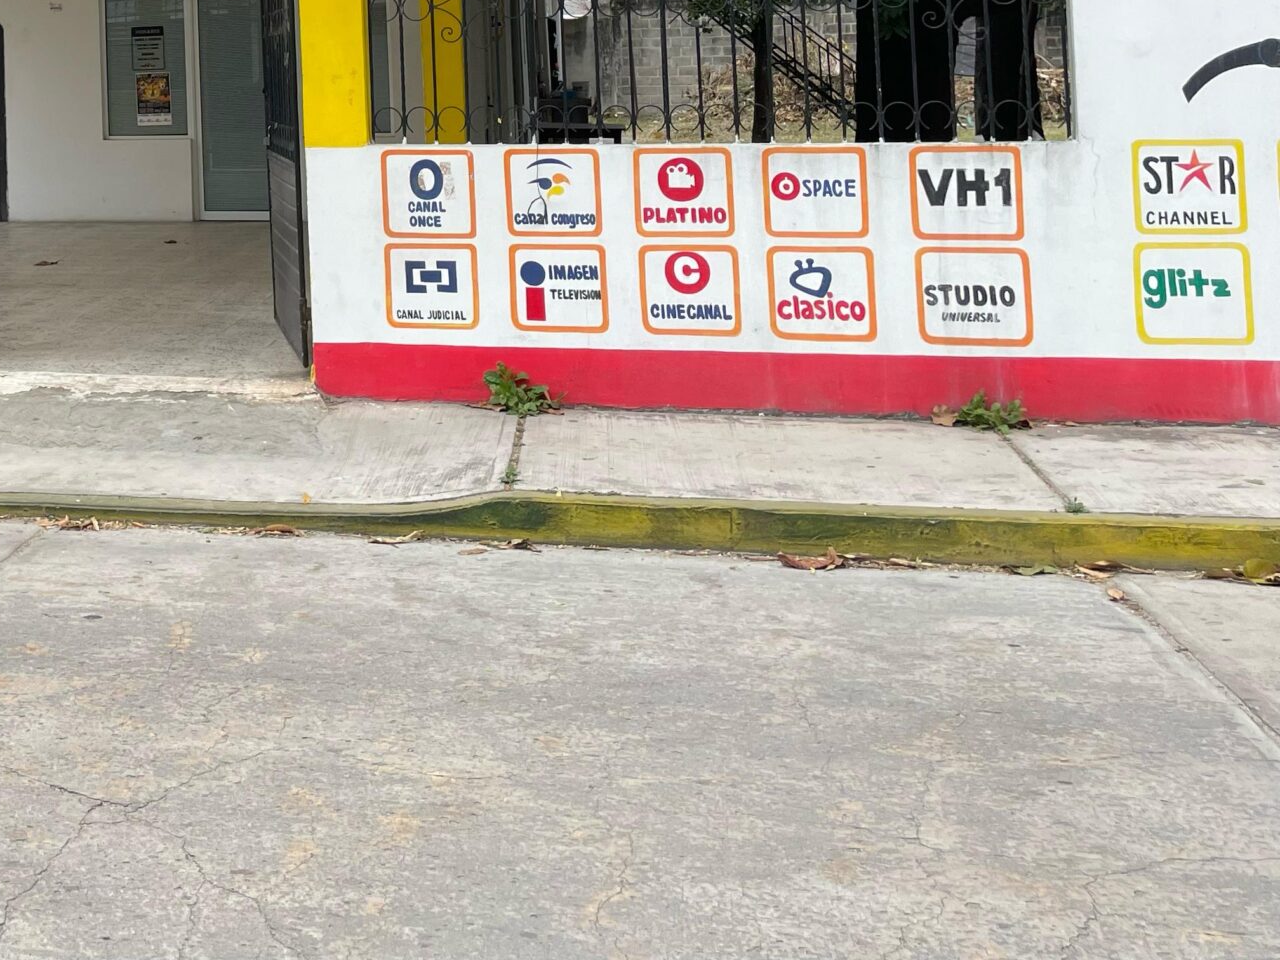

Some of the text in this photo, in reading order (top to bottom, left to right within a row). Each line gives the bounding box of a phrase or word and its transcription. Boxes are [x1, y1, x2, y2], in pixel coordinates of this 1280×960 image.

[802, 179, 856, 197] SPACE
[916, 168, 1012, 208] VH1
[408, 201, 446, 213] CANAL
[643, 207, 726, 223] PLATINO
[410, 216, 441, 227] ONCE
[514, 212, 596, 229] canal congreso
[1146, 211, 1232, 225] CHANNEL
[549, 265, 598, 280] IMAGEN
[550, 288, 602, 300] TELEVISION
[923, 284, 1015, 308] STUDIO
[1143, 269, 1231, 309] glitz
[397, 308, 466, 320] CANAL JUDICIAL
[650, 304, 732, 320] CINECANAL
[777, 292, 866, 321] clasico
[942, 312, 1000, 322] UNIVERSAL
